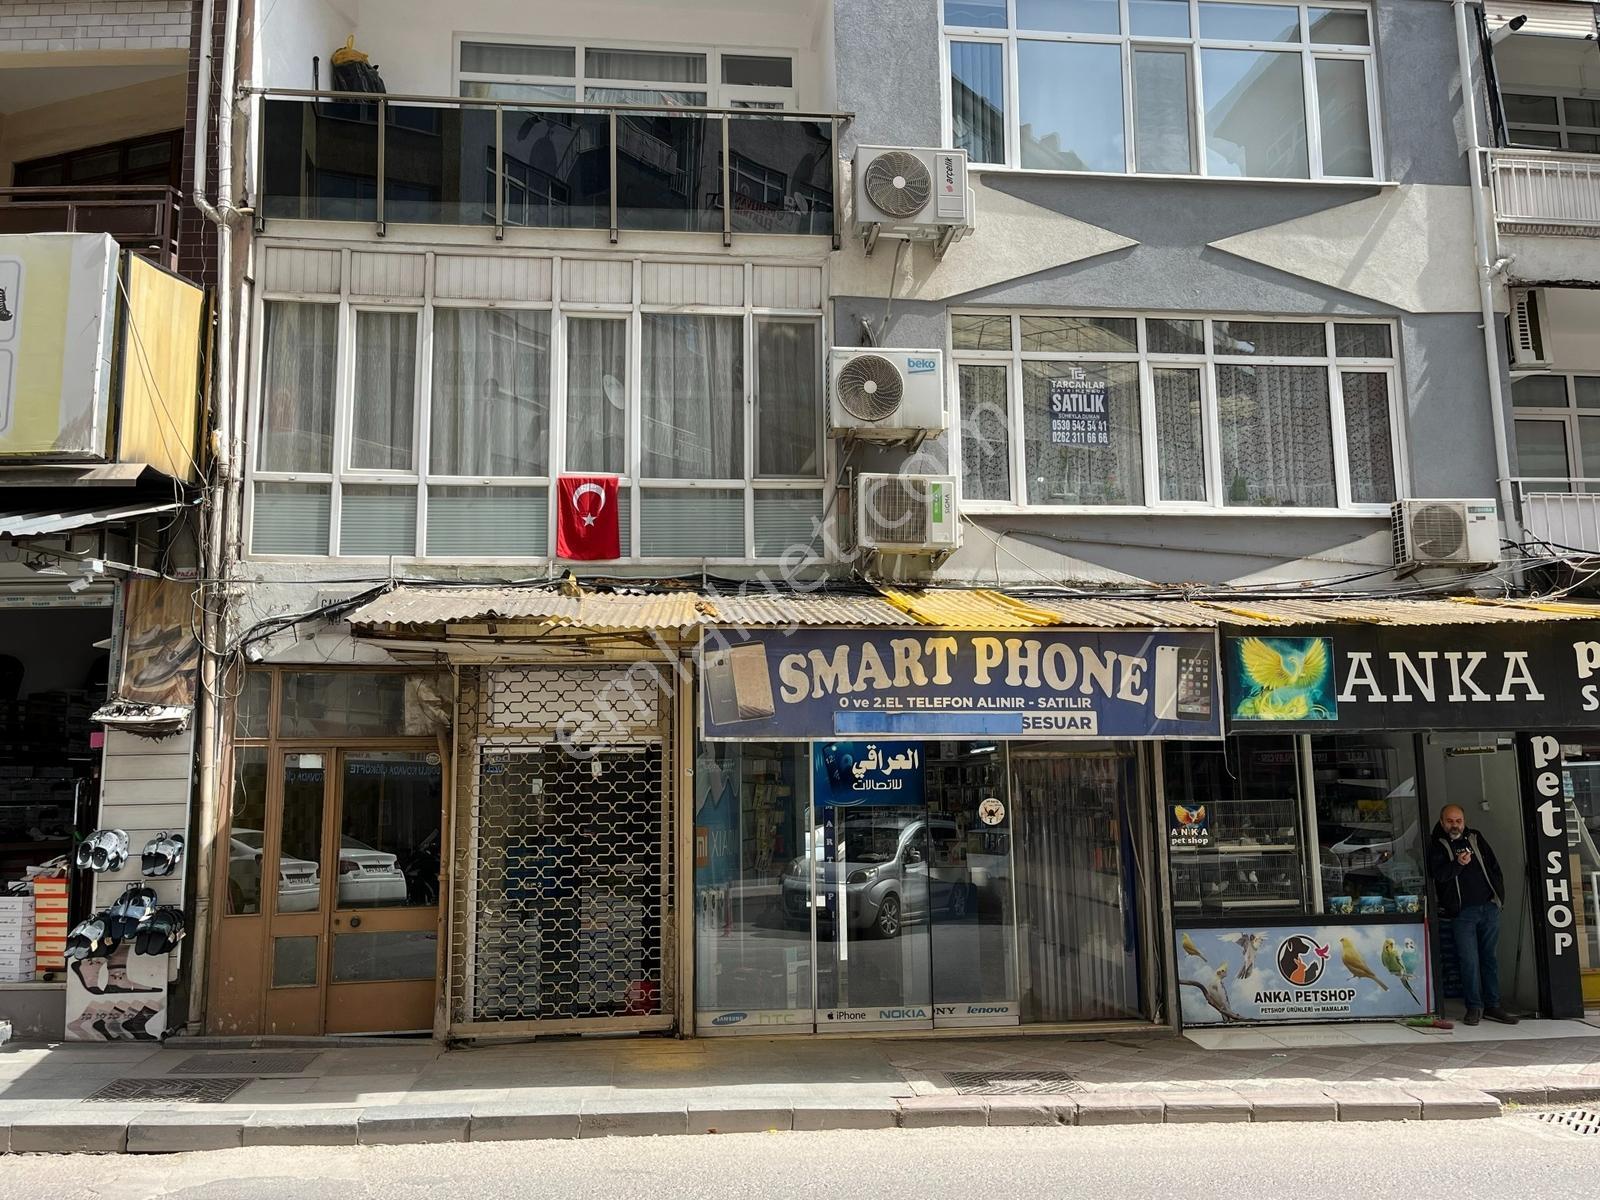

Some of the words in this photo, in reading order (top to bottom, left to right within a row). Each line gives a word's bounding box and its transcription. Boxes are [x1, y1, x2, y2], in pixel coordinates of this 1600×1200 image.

[907, 358, 935, 369] beko
[1051, 380, 1105, 389] TARCANLAR
[1052, 393, 1105, 413] SATILIK
[1052, 420, 1070, 430] 0530
[1072, 420, 1086, 431] 542
[1087, 421, 1096, 431] 54
[1098, 421, 1107, 431] 41
[1052, 432, 1070, 443] 0262
[1072, 432, 1085, 443] 311
[1087, 432, 1097, 443] 66
[779, 637, 958, 703] SMART
[971, 637, 1148, 705] PHONE
[1337, 651, 1545, 702] ANKA
[853, 699, 870, 708] ve
[873, 697, 903, 708] 2.EL
[907, 697, 972, 708] TELEFON
[977, 697, 1025, 708] ALINIR
[1038, 697, 1091, 708] SATILIR
[852, 744, 919, 779] العراقي
[852, 779, 902, 790] للاتصالات
[1530, 735, 1563, 837] pet
[1171, 828, 1208, 836] ANKA
[1171, 837, 1185, 845] pet
[1188, 837, 1208, 845] shop
[1254, 991, 1291, 1003] ANKA
[1295, 990, 1356, 1002] PETSHOP
[836, 1010, 866, 1020] iPhone
[880, 1009, 926, 1019] NOKIA
[967, 1006, 1009, 1014] lenovo
